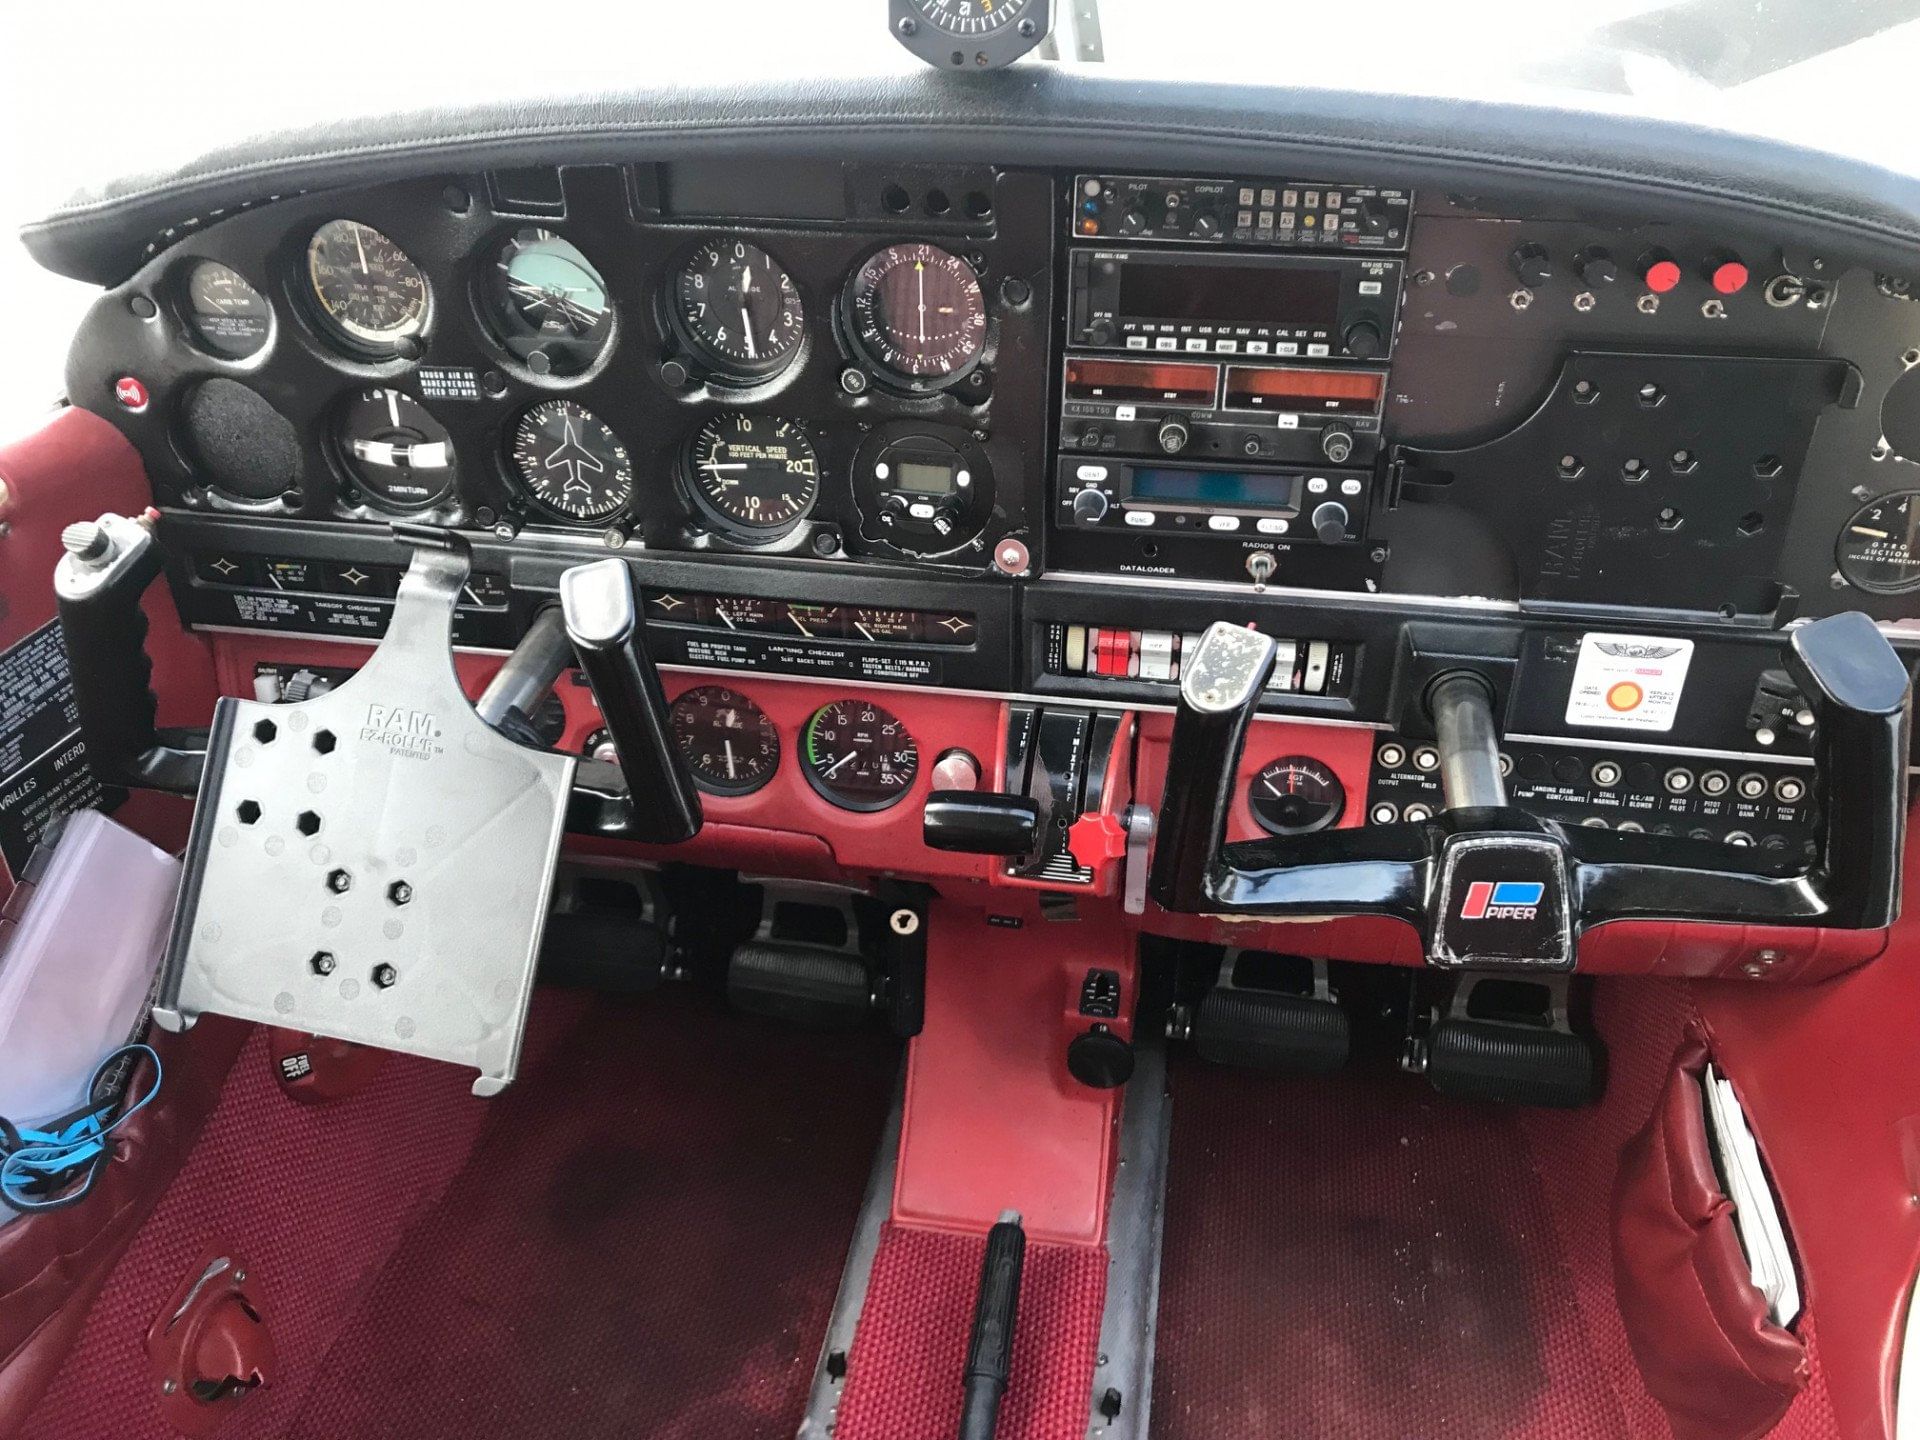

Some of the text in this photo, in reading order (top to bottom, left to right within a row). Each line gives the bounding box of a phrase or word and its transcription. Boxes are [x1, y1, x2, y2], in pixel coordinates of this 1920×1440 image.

[735, 243, 745, 258] 0
[889, 249, 897, 260] S
[919, 245, 929, 254] 21
[710, 252, 719, 266] 9
[765, 254, 770, 269] 1
[947, 256, 960, 269] 24
[864, 268, 876, 279] 15
[405, 277, 419, 288] 80
[694, 274, 704, 289] 8
[781, 274, 790, 289] 2
[968, 281, 980, 293] W
[856, 298, 865, 308] 12
[697, 303, 706, 318] 7
[784, 312, 793, 326] 3
[974, 313, 984, 326] 30
[717, 326, 727, 341] 6
[769, 329, 778, 343] 4
[862, 329, 874, 338] E
[962, 341, 975, 354] 33
[913, 364, 918, 374] 3
[940, 360, 950, 372] N
[420, 371, 444, 379] ROUGH
[448, 371, 461, 379] AIR
[421, 380, 476, 388] MANEUVERING
[423, 388, 446, 396] SPEED
[448, 388, 459, 396] 127
[556, 408, 567, 416] 21
[580, 410, 592, 421] 24
[537, 415, 548, 426] 18
[737, 419, 752, 432] 10
[527, 433, 536, 444] 15
[614, 447, 625, 459] 30
[528, 456, 538, 466] 12
[786, 460, 803, 472] 20
[615, 469, 626, 481] 33
[745, 496, 760, 508] 10
[1898, 502, 1907, 513] 4
[1871, 508, 1882, 520] 2
[1242, 542, 1275, 550] RADIOS
[1872, 542, 1907, 550] GYRO
[1864, 548, 1910, 558] SUCTION
[1120, 565, 1176, 574] DATALOADER
[768, 646, 845, 658] LANDING CHECKLIST
[874, 670, 907, 678] CONDITIONER
[699, 696, 707, 706] 9
[721, 691, 730, 701] 0
[686, 713, 694, 723] 8
[759, 714, 768, 725] 2
[837, 715, 847, 725] 15
[861, 711, 875, 722] 20
[881, 724, 896, 735] 25
[686, 735, 694, 745] 7
[824, 730, 835, 741] 10
[390, 747, 431, 760] PATENTED
[760, 744, 769, 755] 3
[702, 754, 711, 764] 6
[748, 758, 757, 767] 4
[826, 753, 834, 763] 5
[893, 752, 908, 763] 30
[880, 773, 894, 784] 35
[1390, 773, 1425, 781] ALTERNATOR
[0, 777, 37, 811] VRILLES
[1532, 785, 1556, 793] LANDING
[1546, 794, 1585, 802] CONT/LIGHTS
[1593, 798, 1619, 806] WARNING
[1737, 803, 1753, 811] TURN
[1485, 907, 1537, 920] PIPER
[283, 1057, 301, 1078] OFF
[298, 1054, 310, 1074] FUEL
